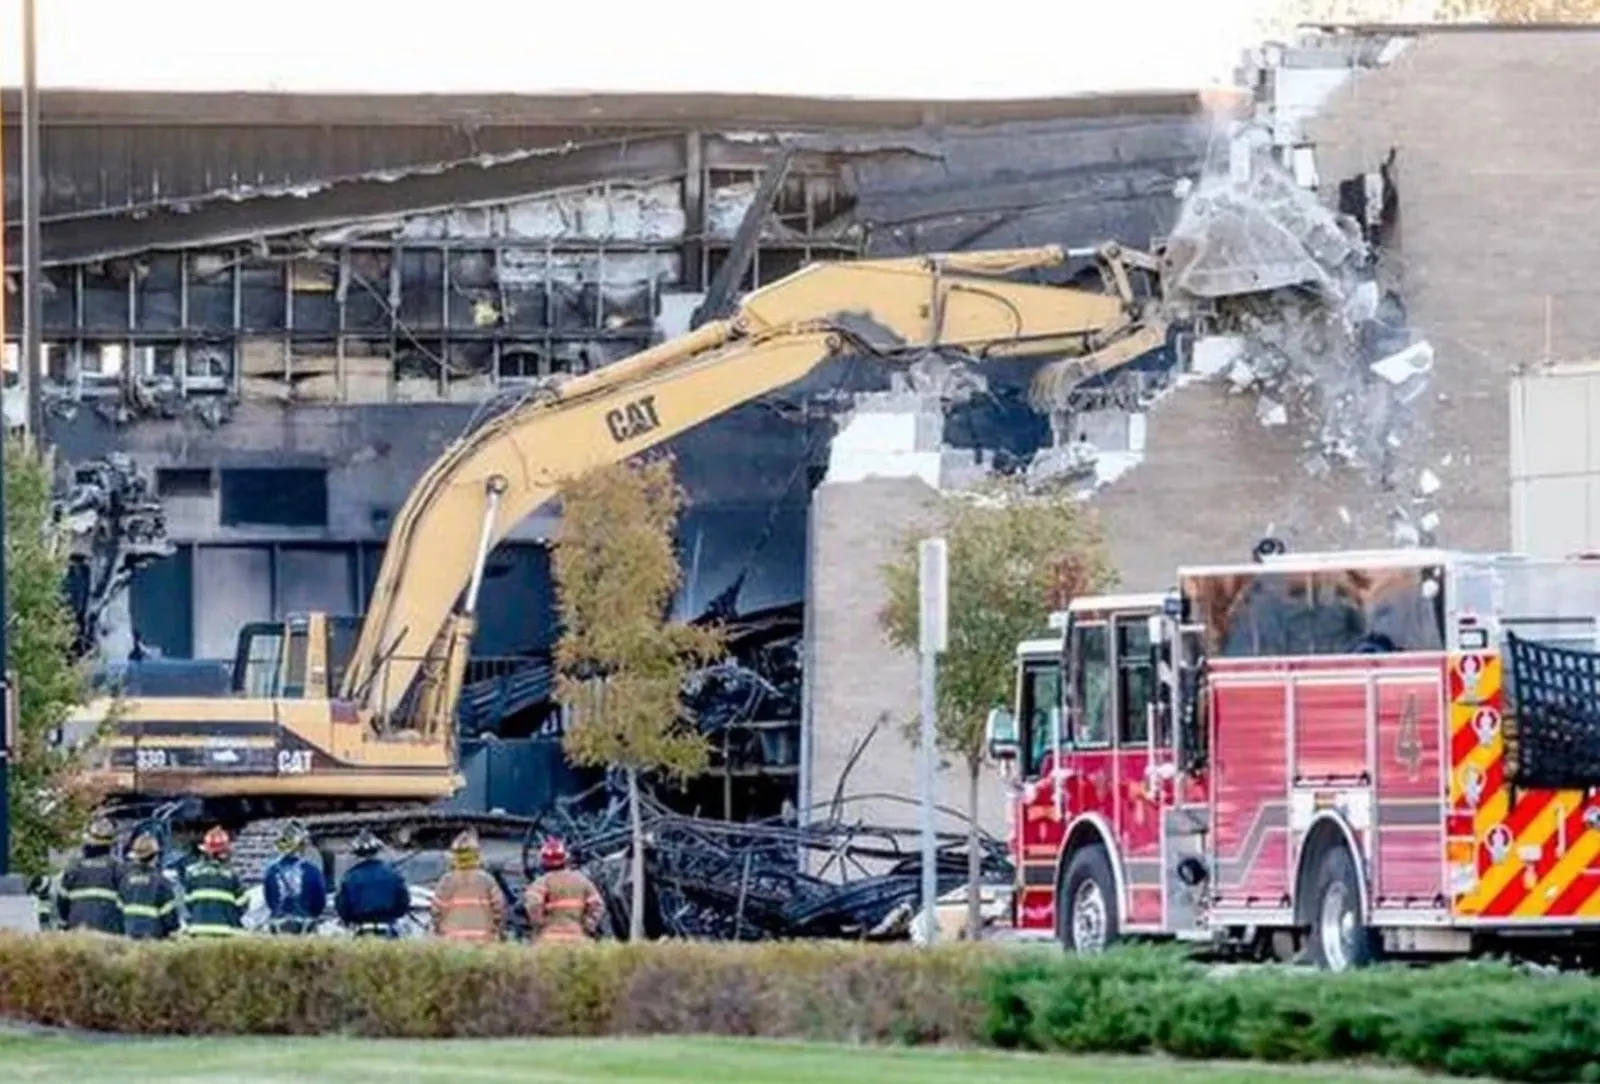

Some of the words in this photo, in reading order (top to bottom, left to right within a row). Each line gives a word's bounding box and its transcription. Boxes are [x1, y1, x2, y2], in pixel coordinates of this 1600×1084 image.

[606, 395, 660, 442] CAT
[1397, 693, 1422, 778] 4
[278, 750, 313, 772] CAT
